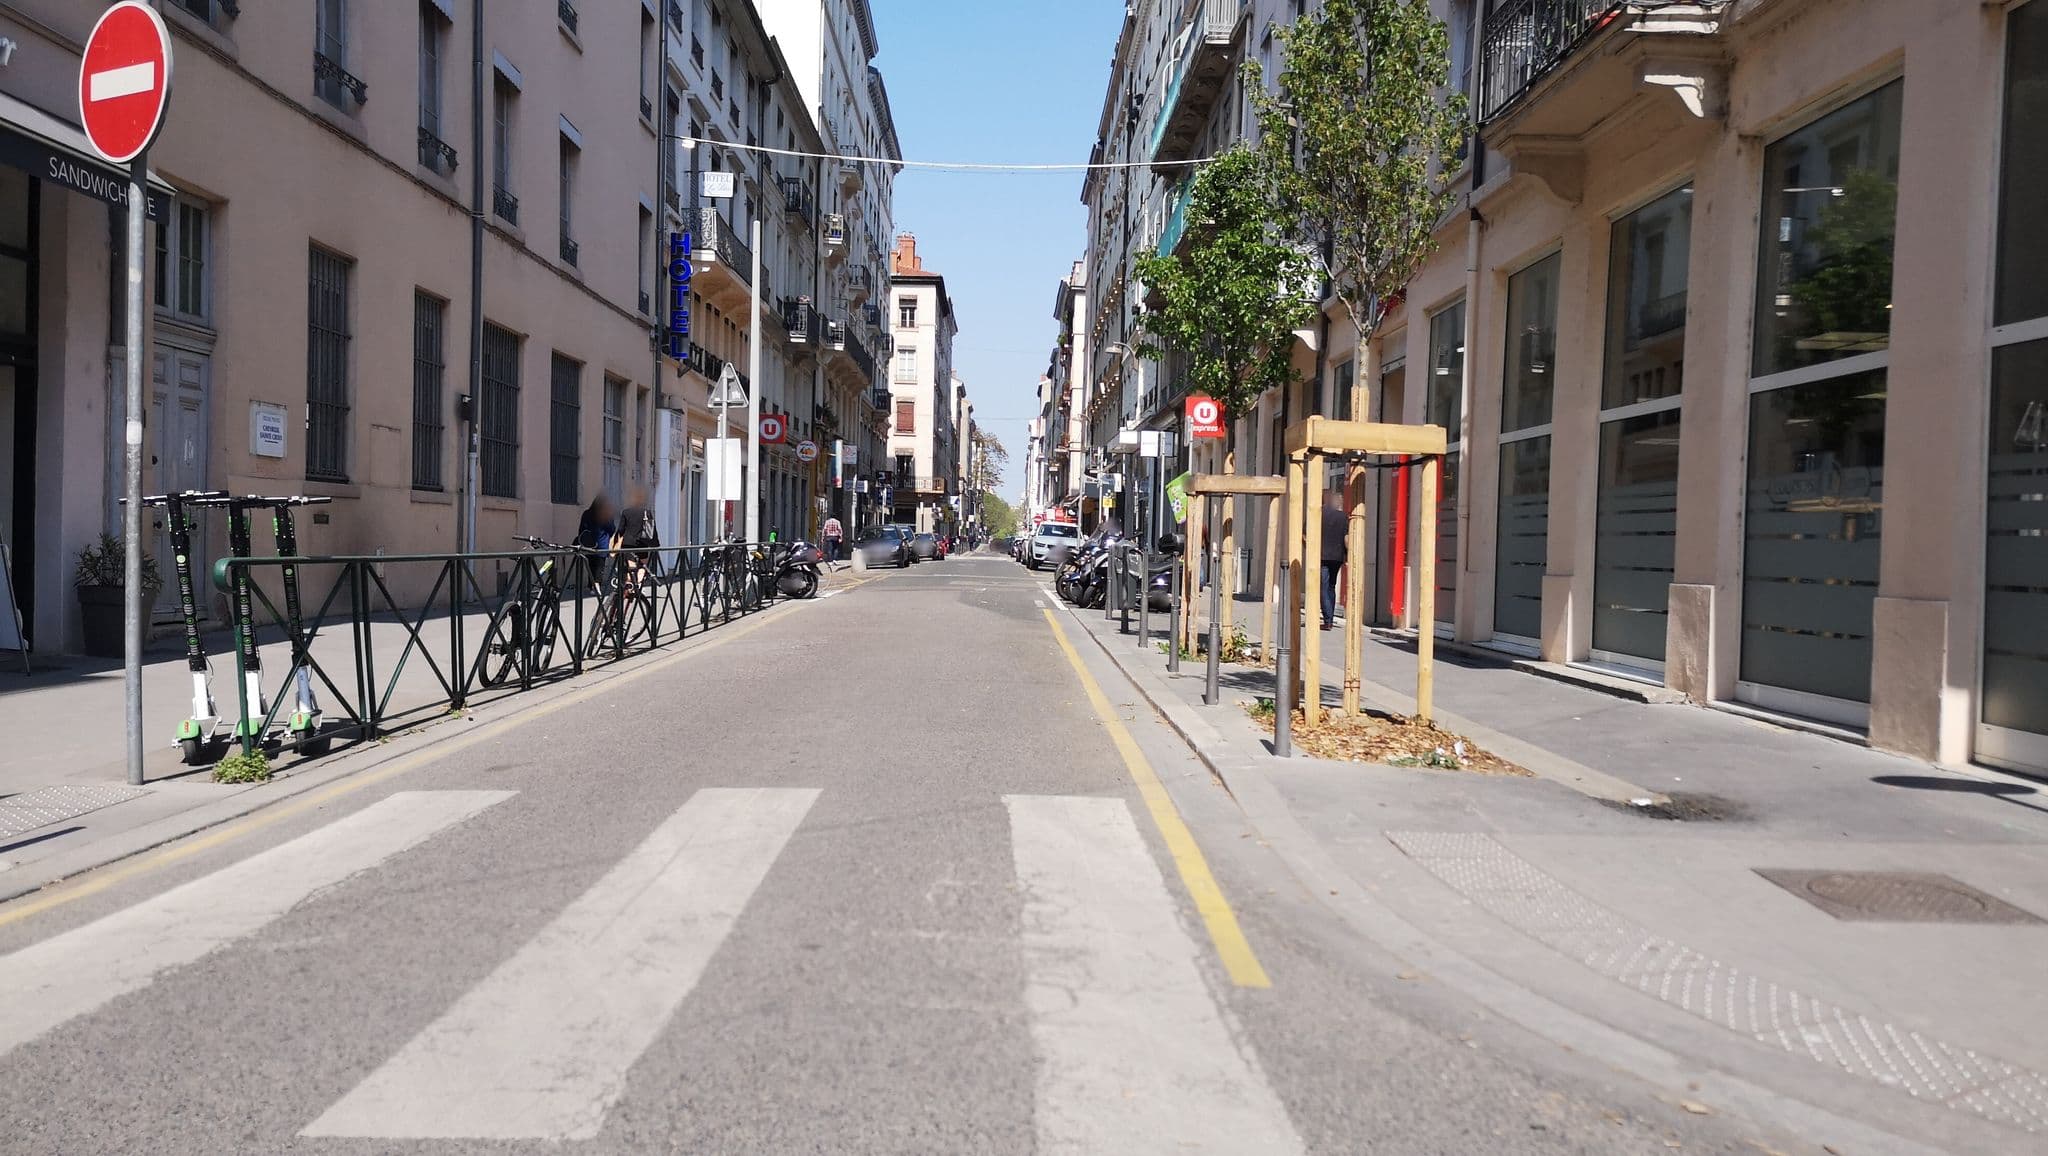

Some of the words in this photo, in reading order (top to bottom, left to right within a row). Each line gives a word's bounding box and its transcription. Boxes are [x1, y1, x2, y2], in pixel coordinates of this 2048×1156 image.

[669, 232, 692, 359] HOTEL
[1200, 408, 1211, 418] U
[764, 423, 777, 436] U
